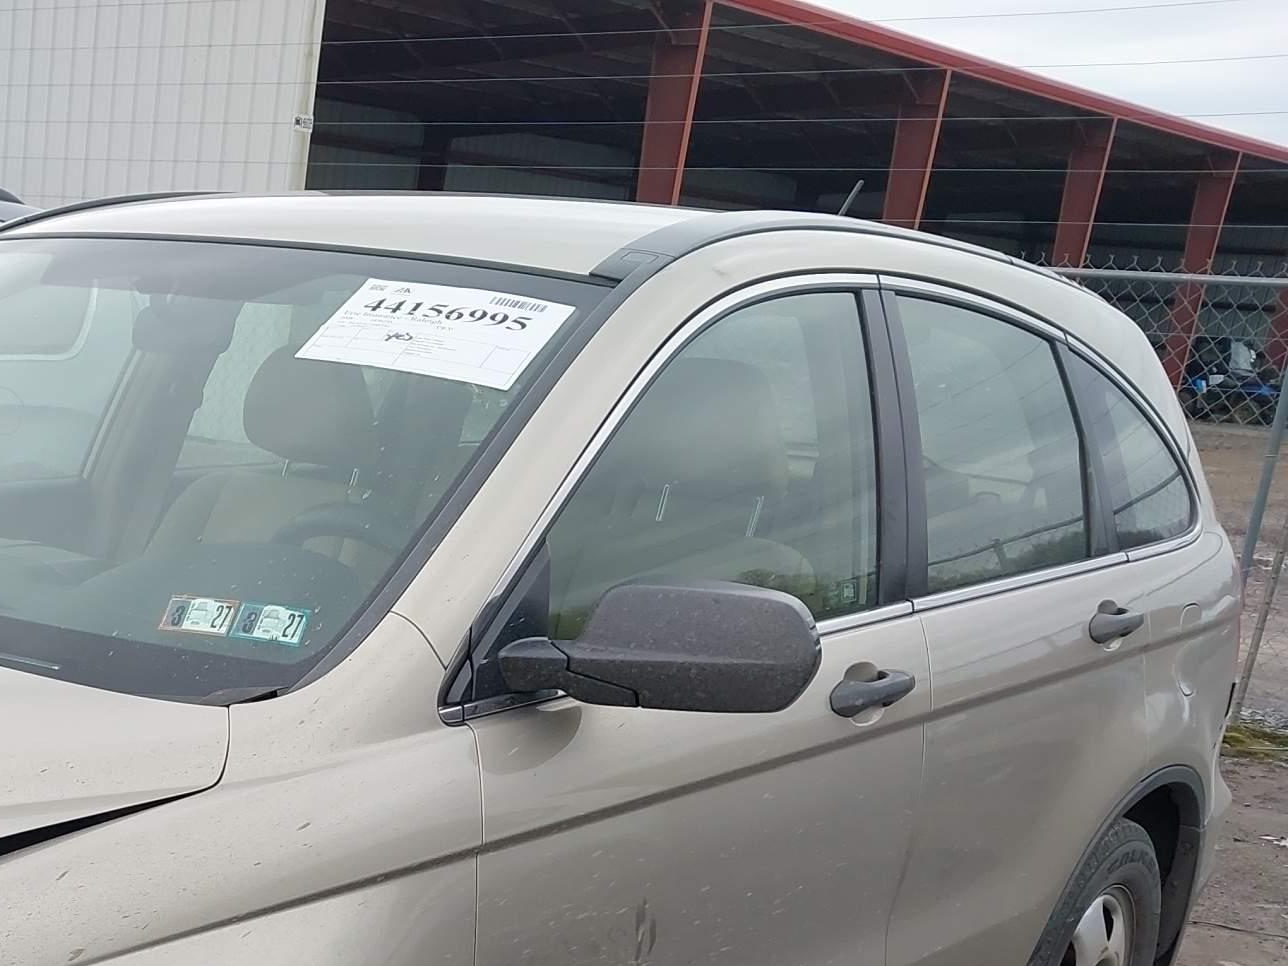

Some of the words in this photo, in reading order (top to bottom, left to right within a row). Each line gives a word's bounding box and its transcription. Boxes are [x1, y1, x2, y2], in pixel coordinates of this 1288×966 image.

[363, 298, 533, 331] 44156995
[210, 605, 233, 631] 27
[281, 613, 305, 639] 27
